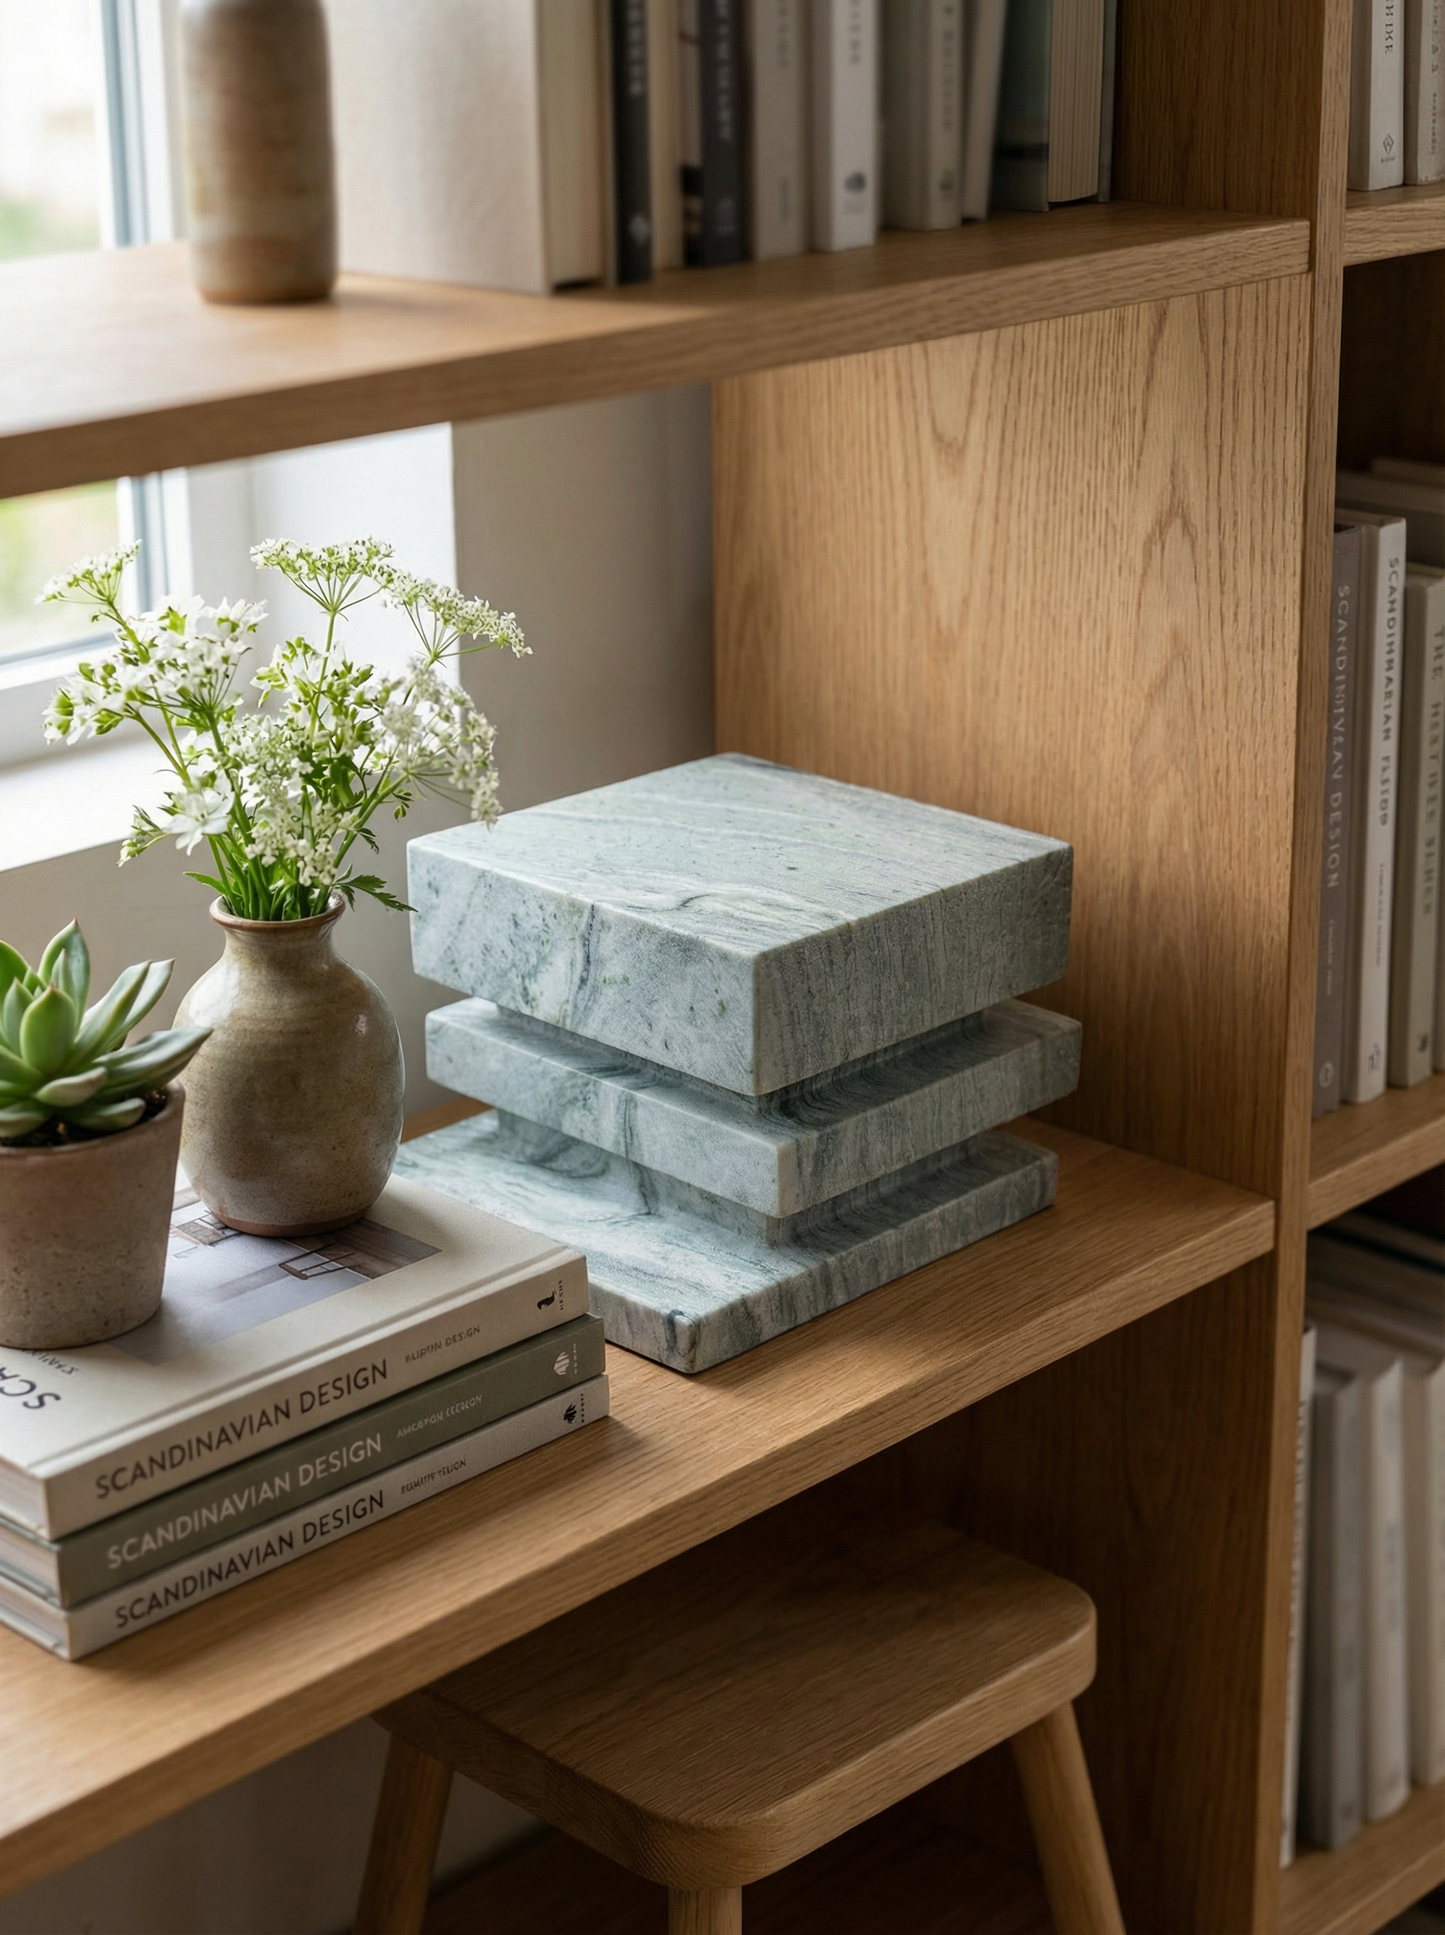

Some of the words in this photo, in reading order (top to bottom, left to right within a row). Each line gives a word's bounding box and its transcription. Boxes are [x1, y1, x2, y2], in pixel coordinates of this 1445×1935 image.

[96, 1398, 291, 1499] SCANDINAVIAN
[300, 1358, 388, 1414] DESIGN
[108, 1471, 291, 1570] SCANDINAVIAN
[299, 1432, 382, 1487] DESIGN
[115, 1530, 294, 1629] SCANDINAVIAN
[302, 1489, 385, 1544] DESIGN
